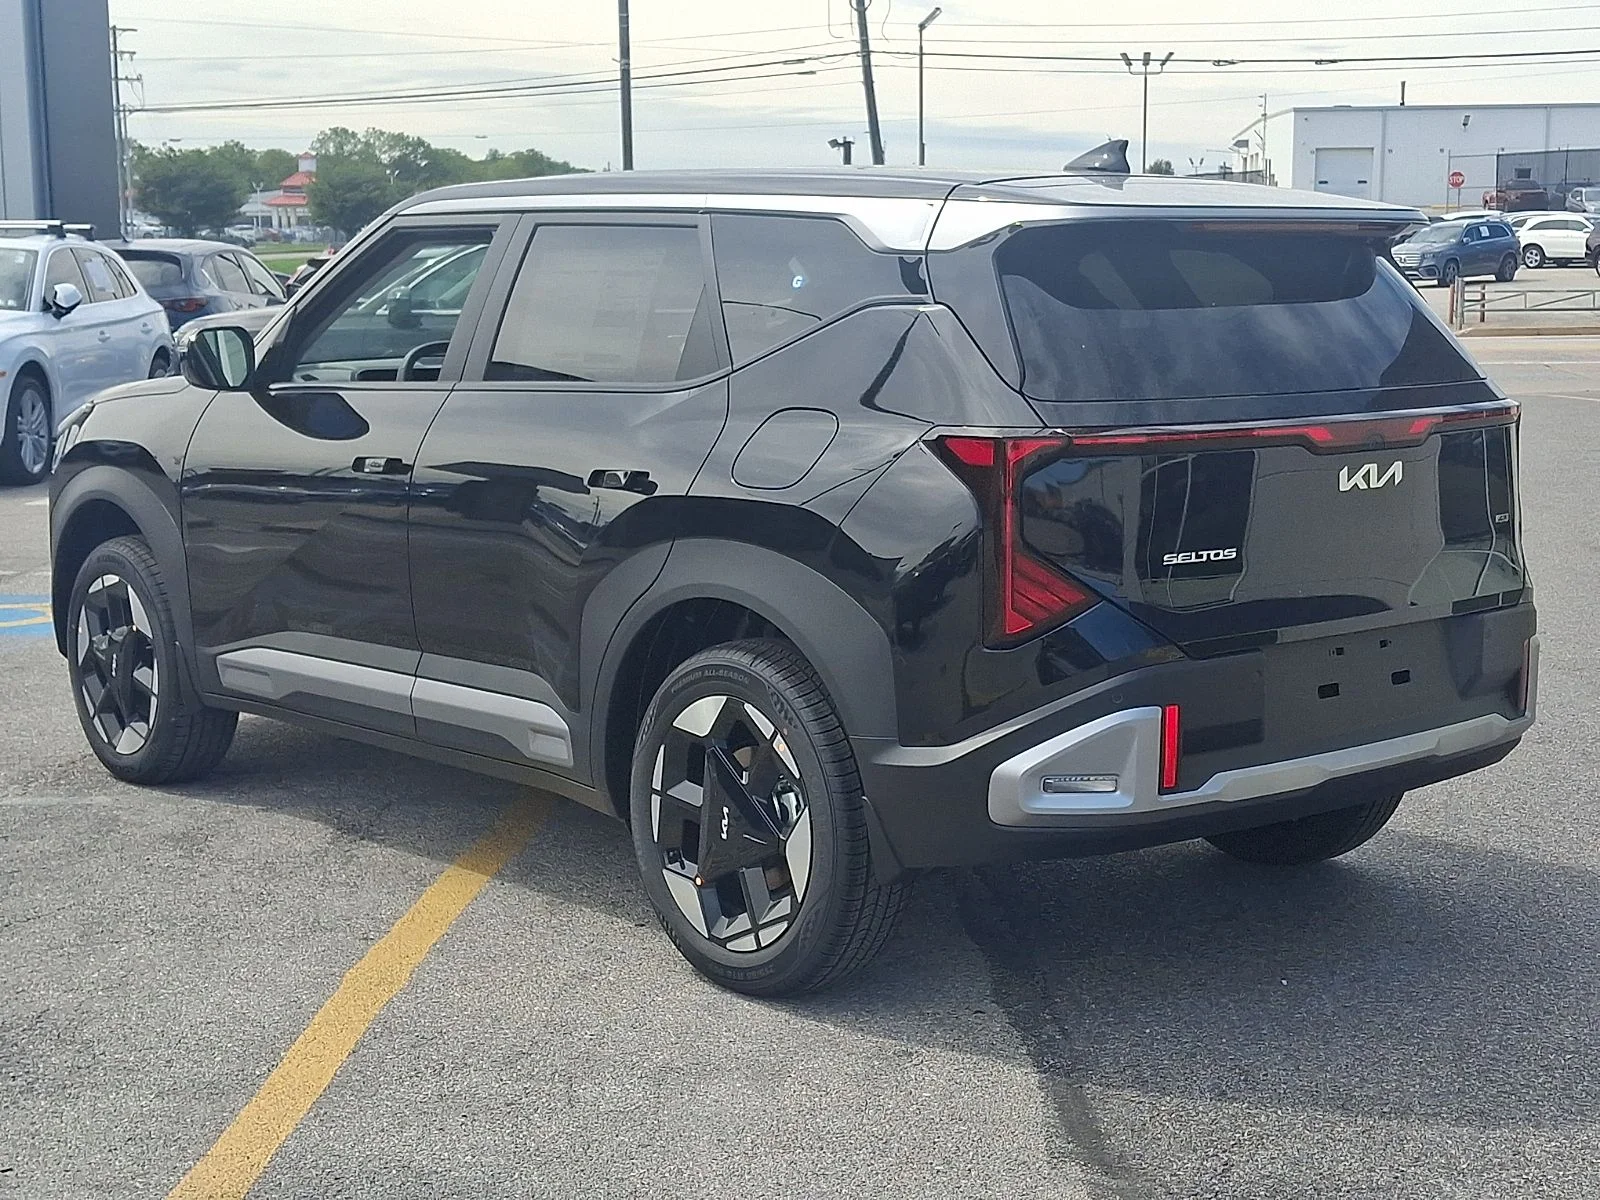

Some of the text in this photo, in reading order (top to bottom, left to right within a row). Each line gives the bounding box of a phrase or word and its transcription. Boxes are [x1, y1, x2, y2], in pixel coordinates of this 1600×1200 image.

[1449, 175, 1464, 184] STOP
[792, 276, 803, 288] G
[1339, 461, 1402, 492] KIA
[1163, 548, 1237, 565] SELTOS
